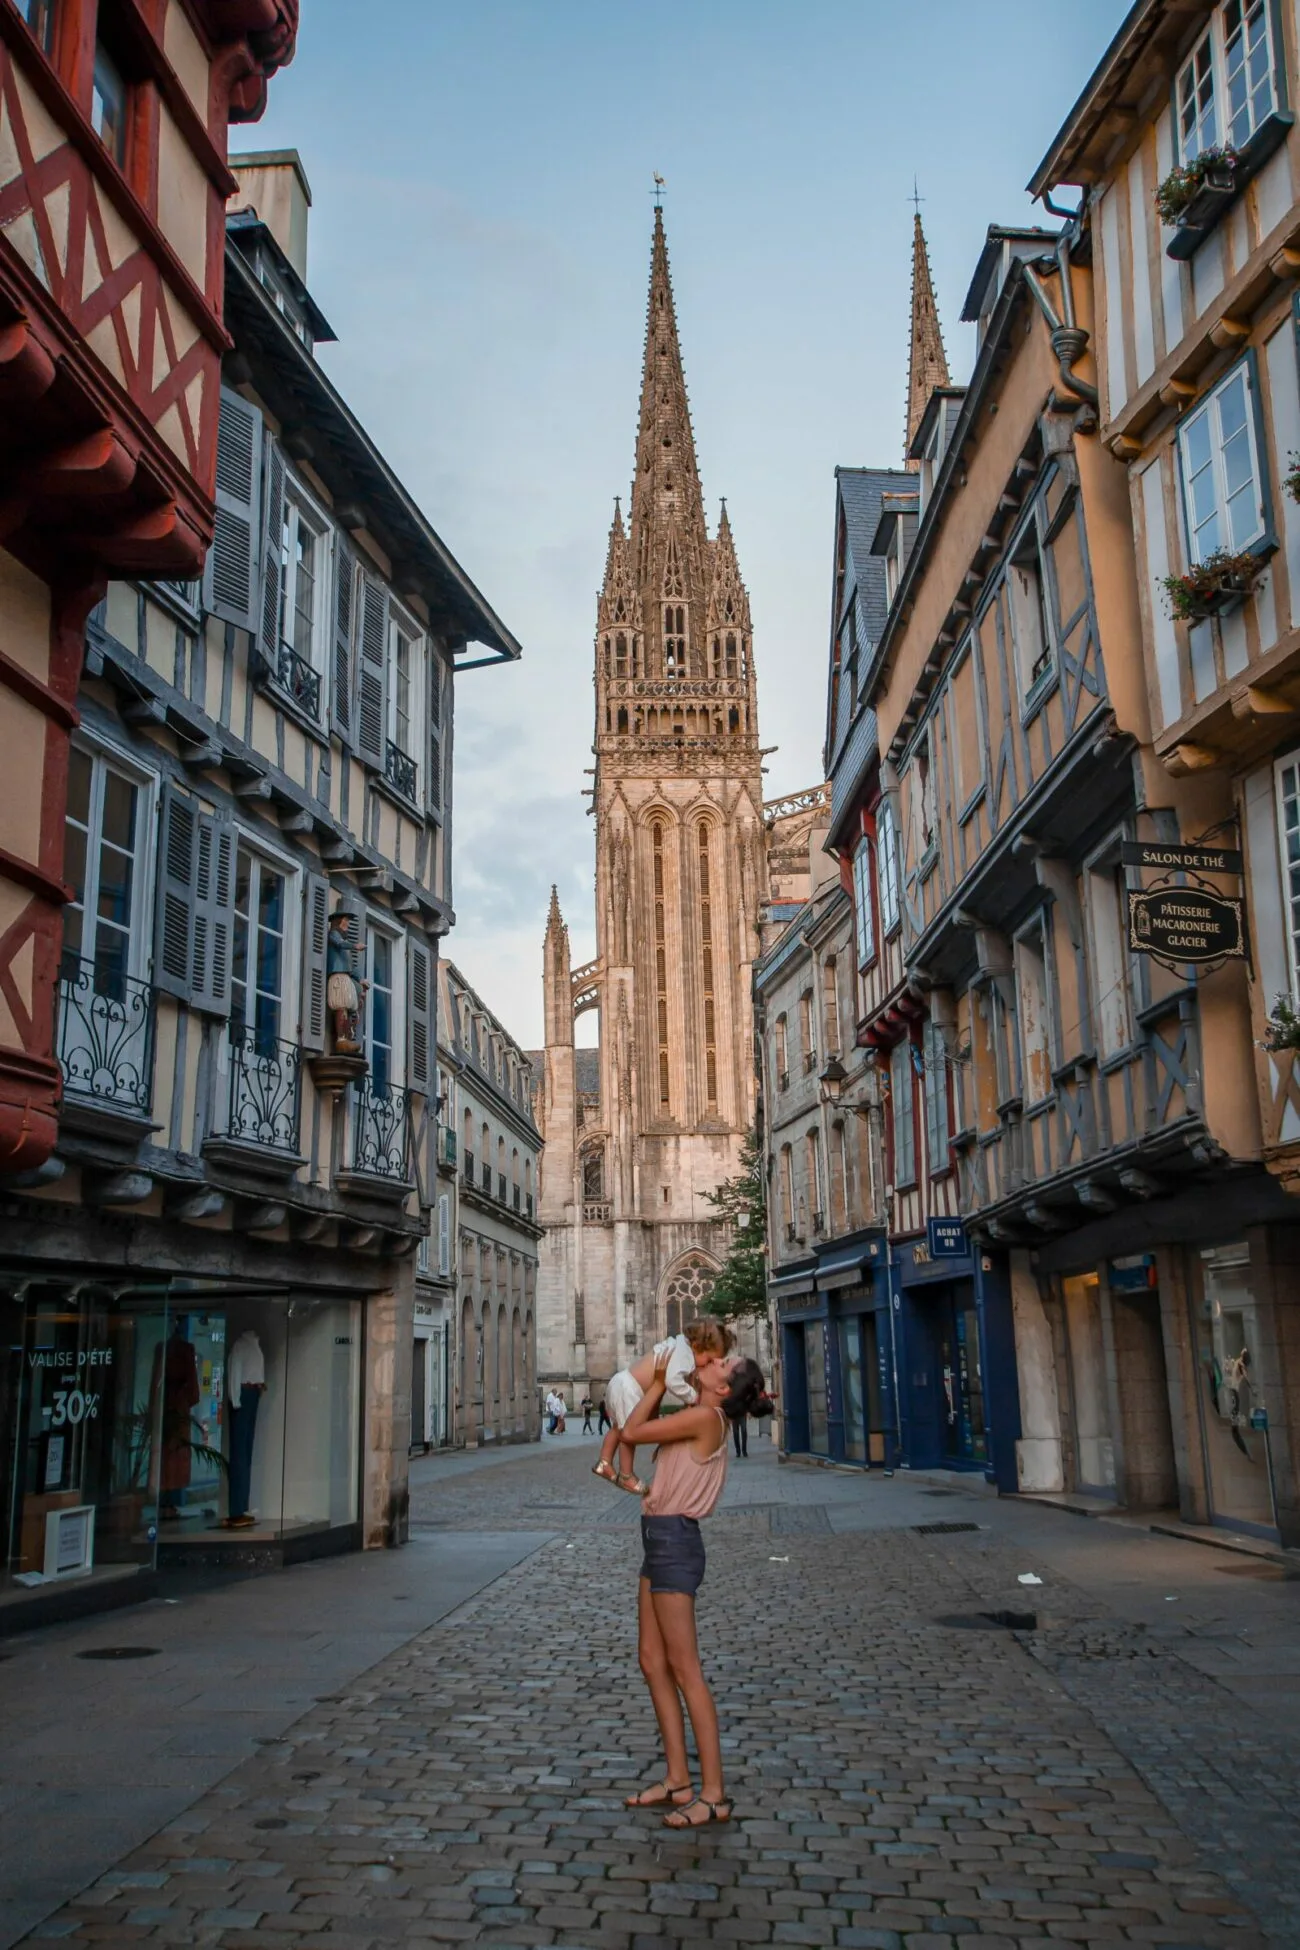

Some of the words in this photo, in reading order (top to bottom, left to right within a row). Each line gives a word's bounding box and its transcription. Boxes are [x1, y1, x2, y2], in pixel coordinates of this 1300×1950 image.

[1142, 851, 1182, 865] SALON
[1184, 855, 1200, 866] DE
[1202, 855, 1225, 868] THÉ
[1160, 902, 1212, 919] PÂTISSERIE
[1152, 918, 1221, 934] MACARONERIE
[1167, 935, 1207, 948] GLACIER
[936, 1227, 961, 1237] ACHAT
[28, 1352, 73, 1368] VALISE
[77, 1347, 113, 1366] D'ÉTÉ
